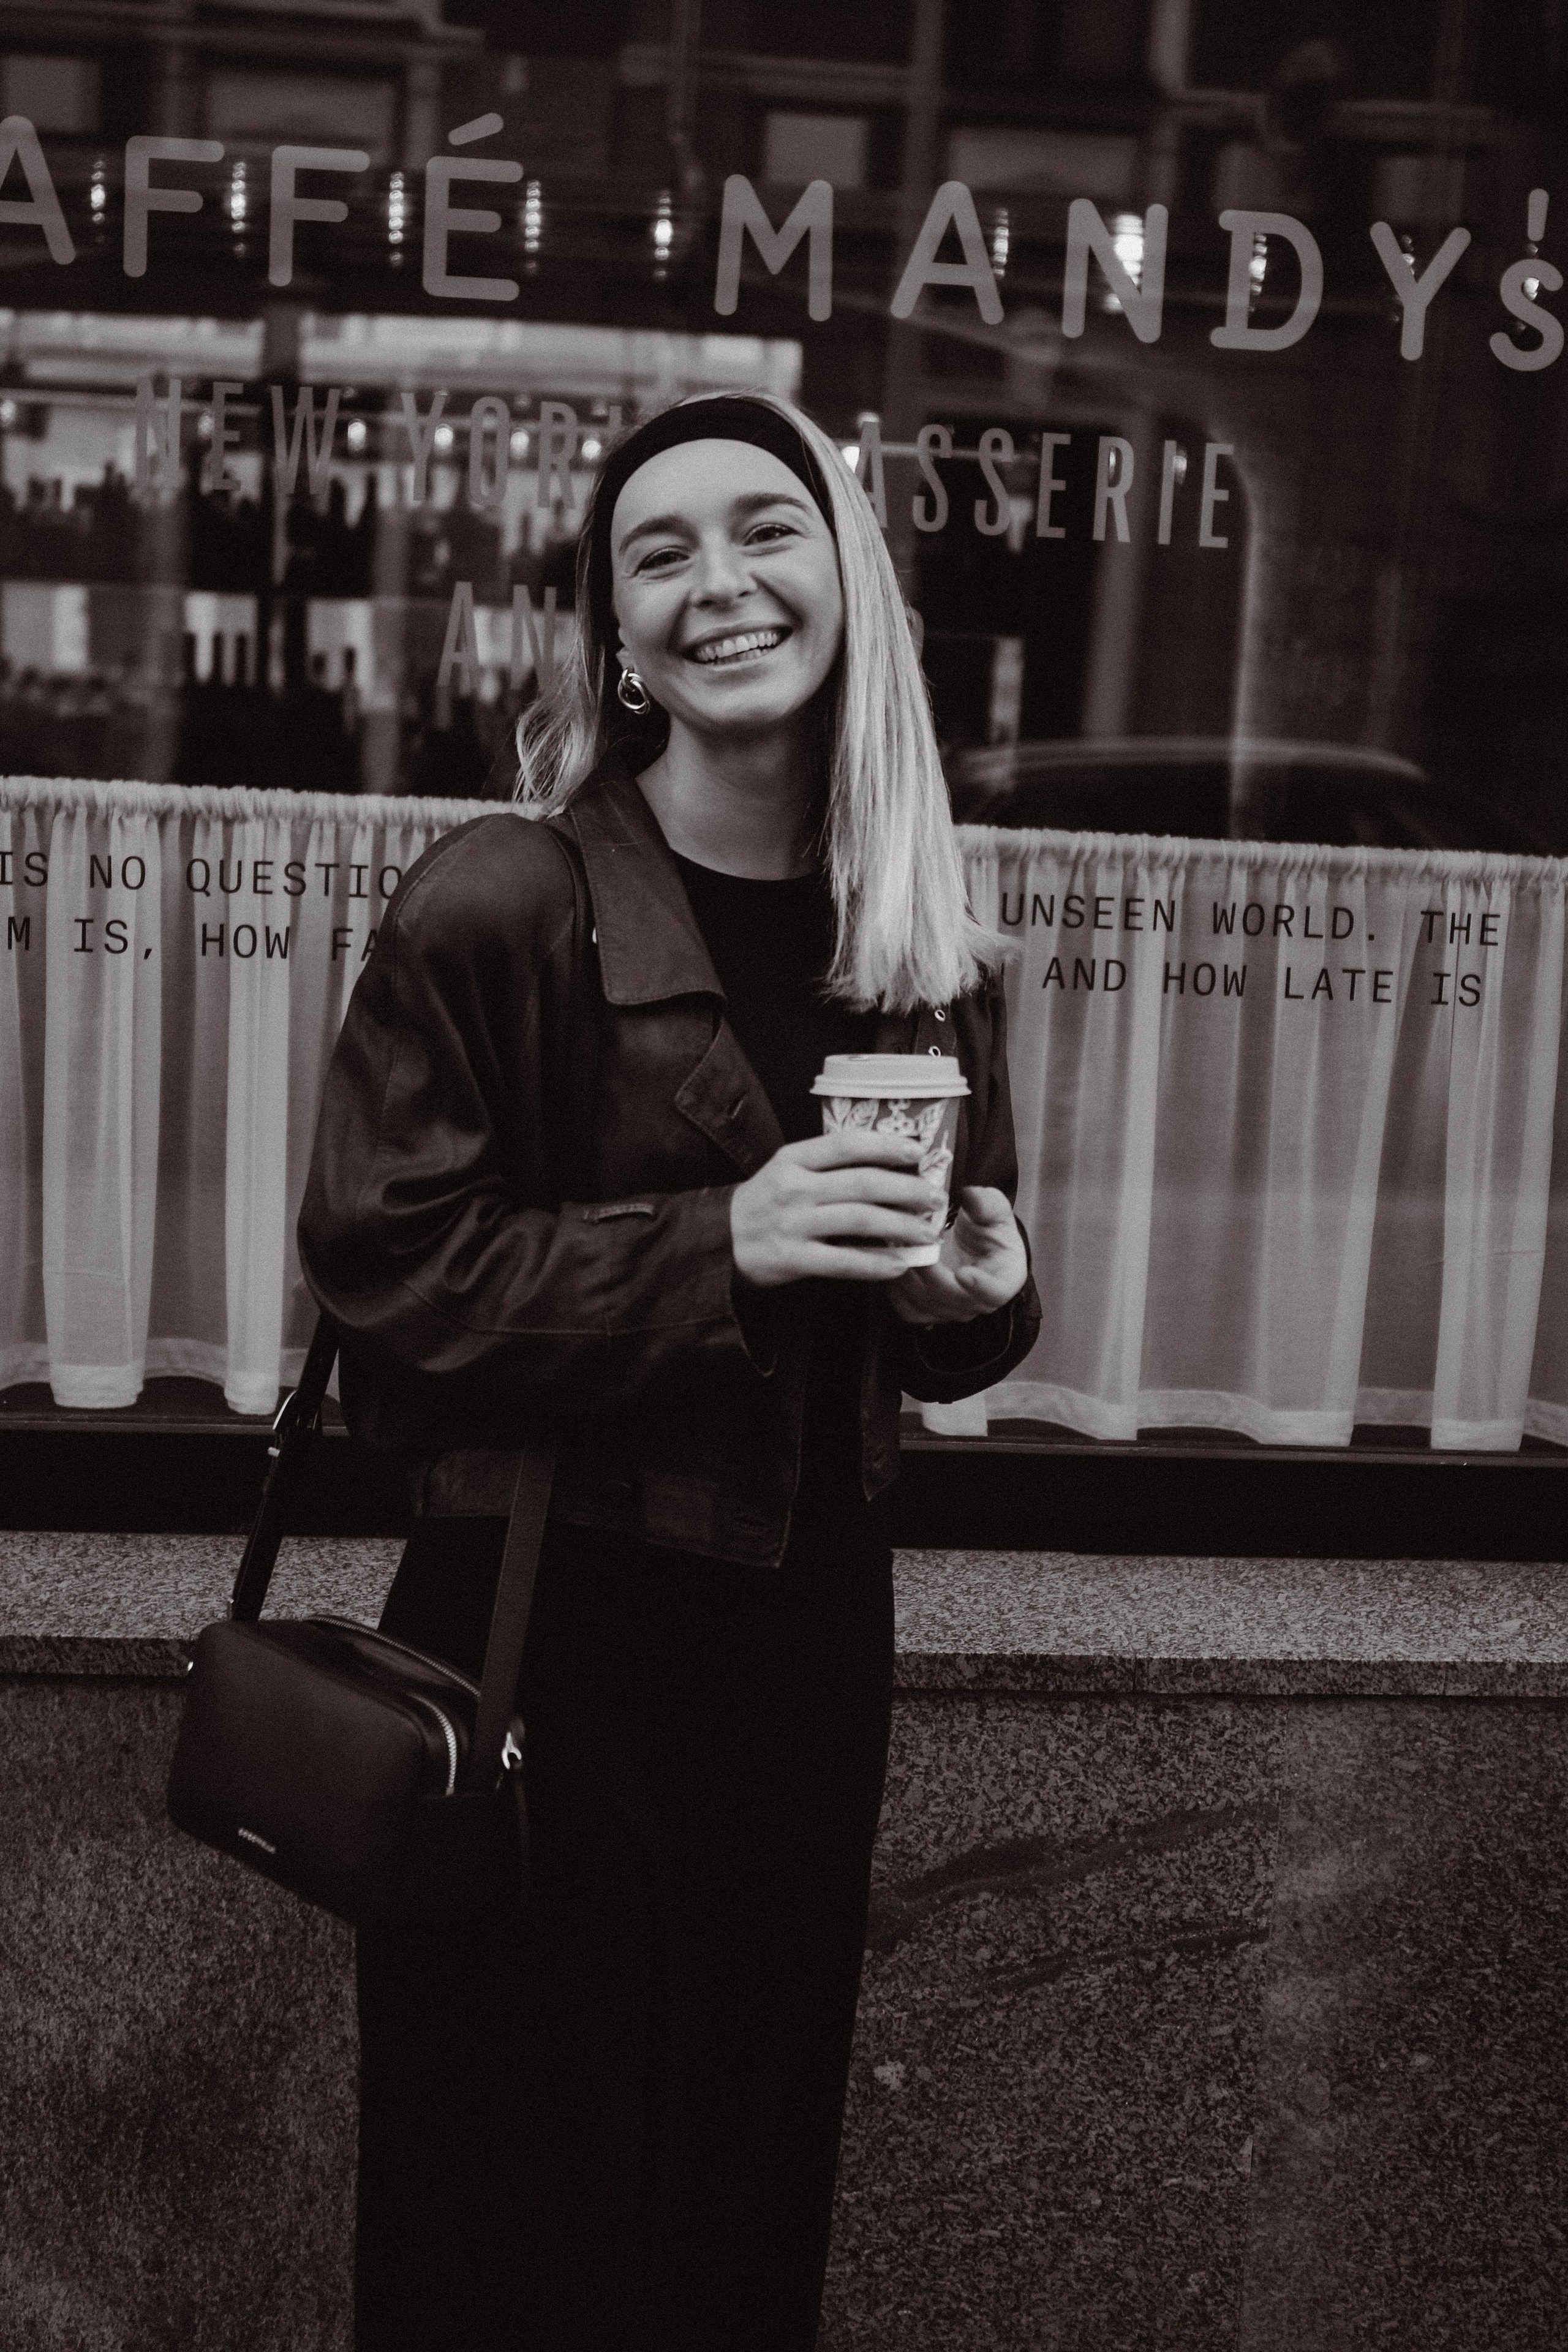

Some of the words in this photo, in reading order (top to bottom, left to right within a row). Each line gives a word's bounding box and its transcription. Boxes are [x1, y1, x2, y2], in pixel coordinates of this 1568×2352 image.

[0, 112, 524, 302] AFFÉ
[135, 377, 341, 495] NEW
[855, 420, 1235, 549] ASSERIE
[0, 851, 48, 887] IS
[89, 854, 146, 890] NO
[185, 858, 403, 900] QUESTIO
[1001, 892, 1175, 933] UNSEEN
[1212, 901, 1375, 941] WORLD.
[1420, 910, 1501, 946] THE
[74, 918, 153, 960] IS,
[201, 922, 290, 959] HOW
[1041, 956, 1128, 992] AND
[1163, 962, 1247, 997] HOW
[1284, 967, 1394, 1003] LATE
[1430, 972, 1482, 1007] IS
